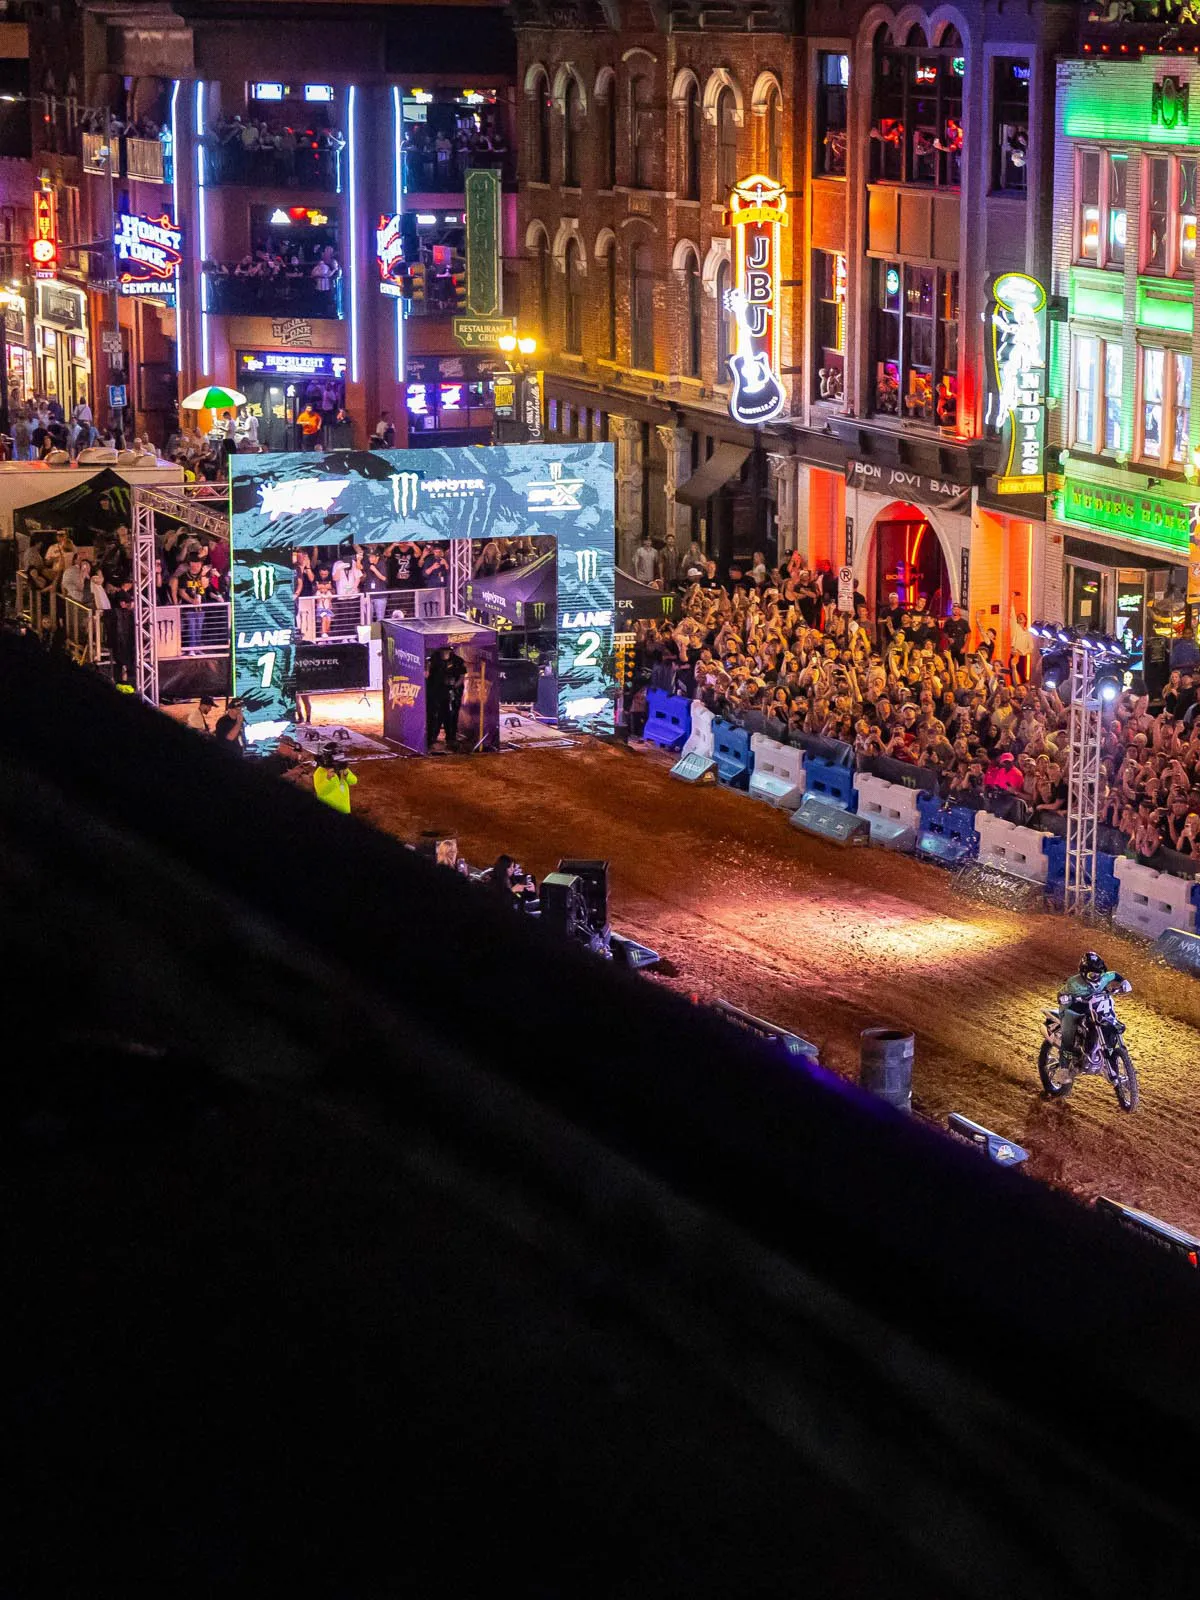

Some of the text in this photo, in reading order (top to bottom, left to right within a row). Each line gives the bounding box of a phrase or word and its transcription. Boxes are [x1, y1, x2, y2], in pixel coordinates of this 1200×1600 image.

[121, 214, 181, 249] HONKY
[115, 235, 167, 268] TONK
[122, 283, 175, 294] CENTRAL
[460, 324, 508, 333] RESTAURANT
[466, 333, 473, 341] &
[1020, 372, 1041, 475] NUDIES
[420, 478, 485, 493] MONSTER
[854, 461, 961, 497] BON JOVI BAR
[562, 611, 613, 628] LANE
[237, 629, 292, 648] LANE
[573, 631, 601, 666] 2
[257, 652, 276, 688] 1
